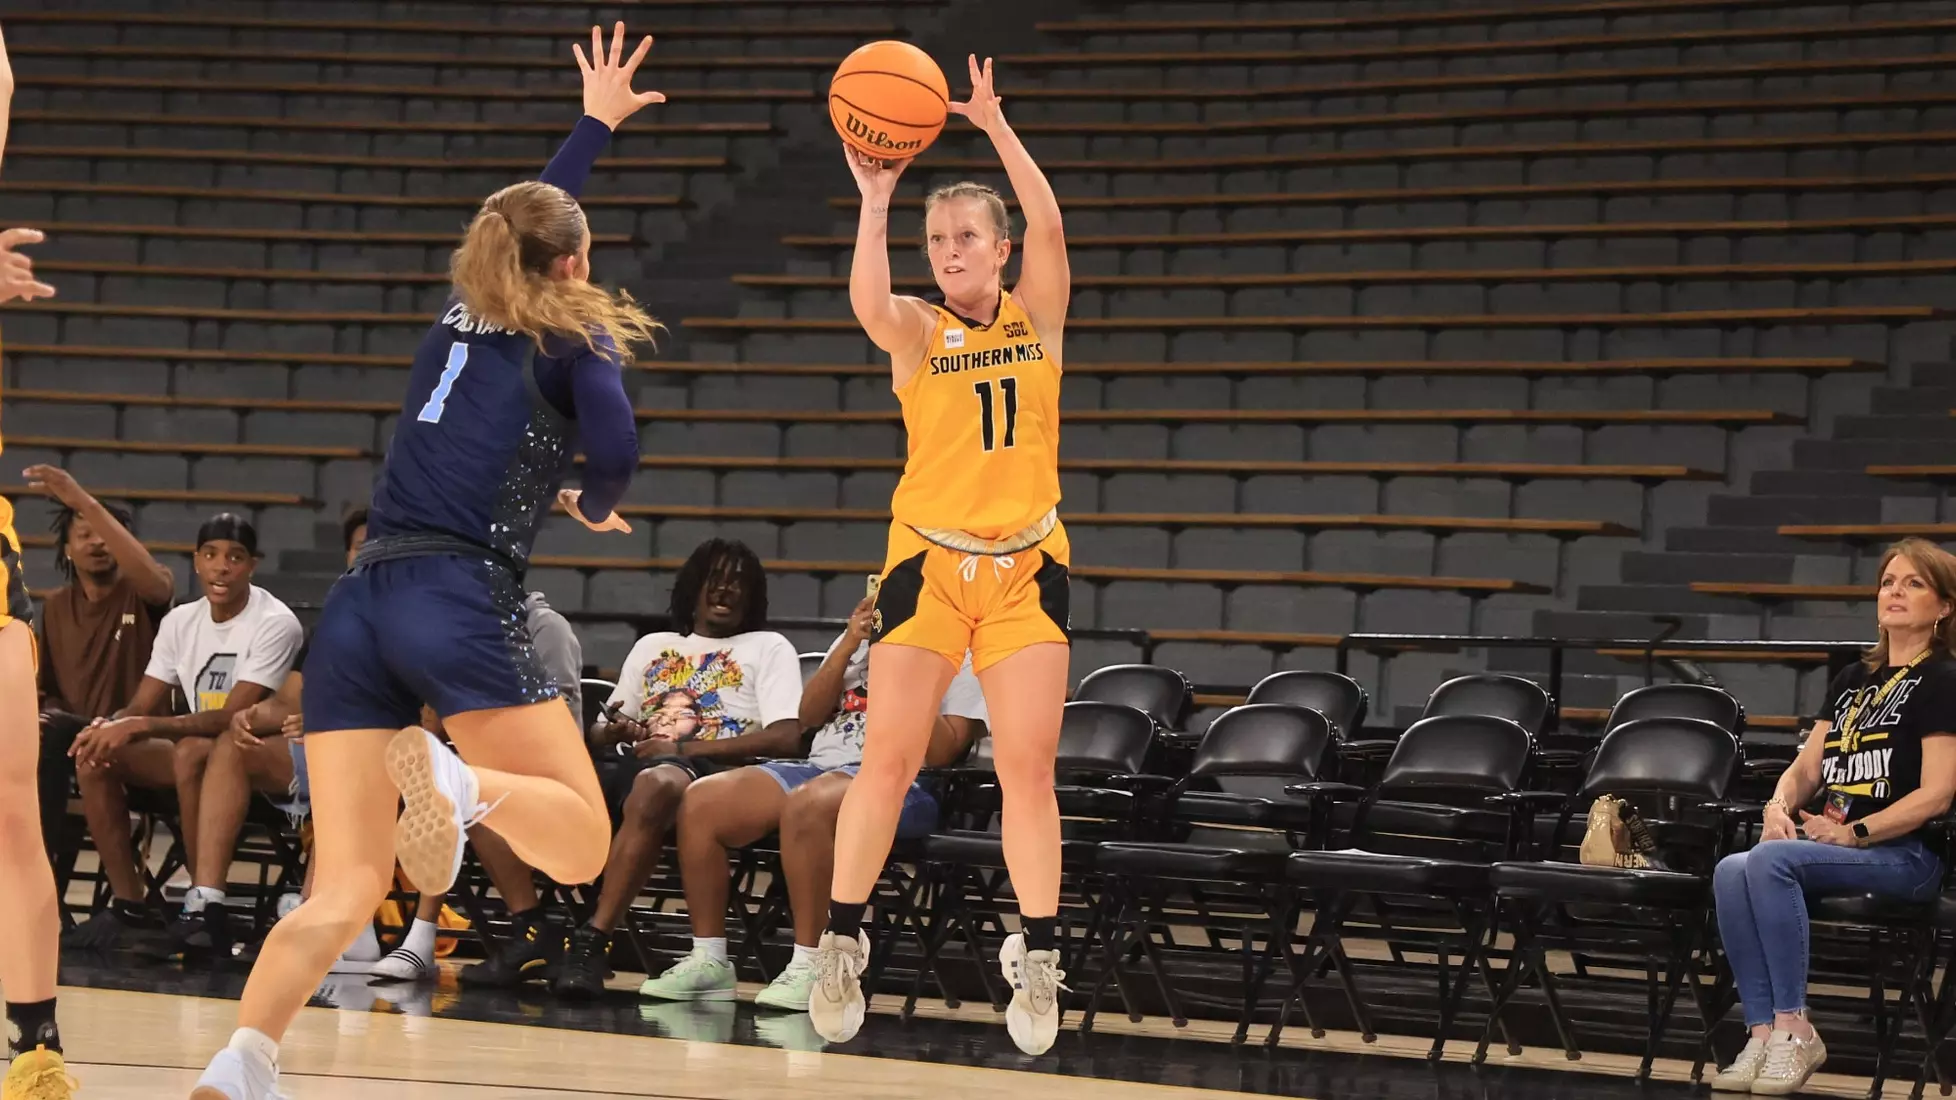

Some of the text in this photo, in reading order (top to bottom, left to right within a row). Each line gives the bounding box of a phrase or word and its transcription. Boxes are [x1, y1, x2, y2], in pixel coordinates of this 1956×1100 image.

[846, 112, 922, 150] Wilson
[930, 343, 1044, 375] SOUTHERN MISS
[417, 341, 469, 424] 1
[973, 375, 1018, 454] 11
[208, 670, 227, 690] TO
[1874, 781, 1886, 799] 11
